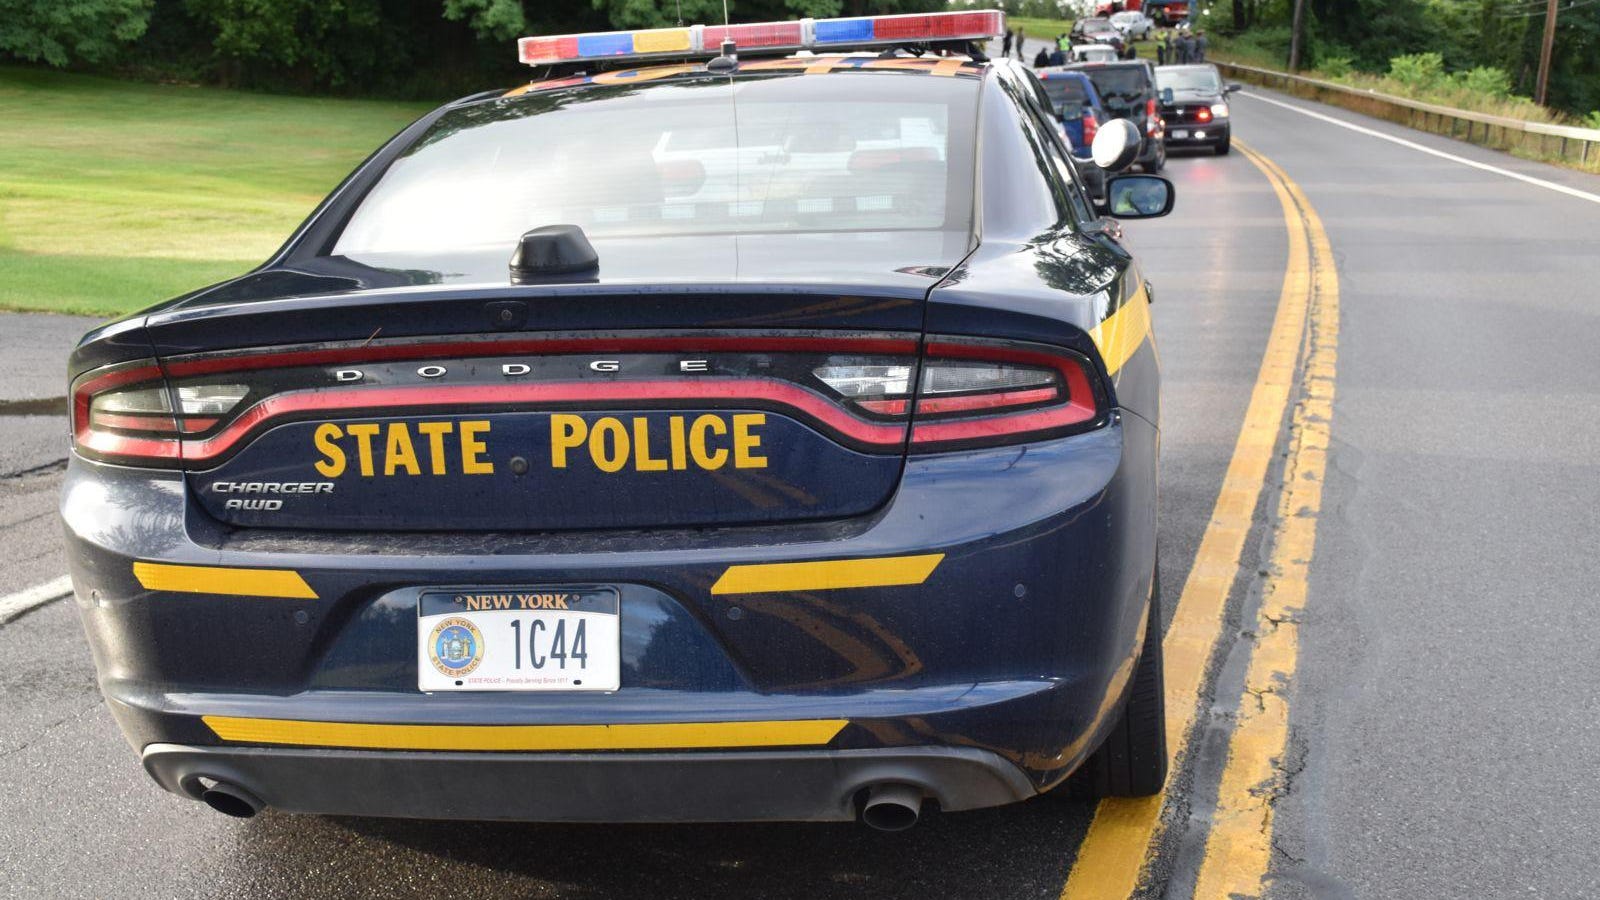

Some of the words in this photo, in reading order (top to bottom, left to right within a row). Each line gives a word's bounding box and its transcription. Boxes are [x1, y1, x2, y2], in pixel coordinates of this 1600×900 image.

[336, 359, 709, 381] DODGE
[313, 420, 495, 479] STATE
[549, 413, 769, 473] POLICE
[211, 481, 336, 495] CHARGER
[225, 499, 284, 511] AWD
[466, 595, 512, 611] NEW
[515, 593, 569, 610] YORK
[435, 620, 452, 634] NEW
[456, 620, 476, 634] YORK
[510, 618, 588, 670] 1C44
[432, 656, 455, 677] STATE
[456, 656, 481, 677] POLICE
